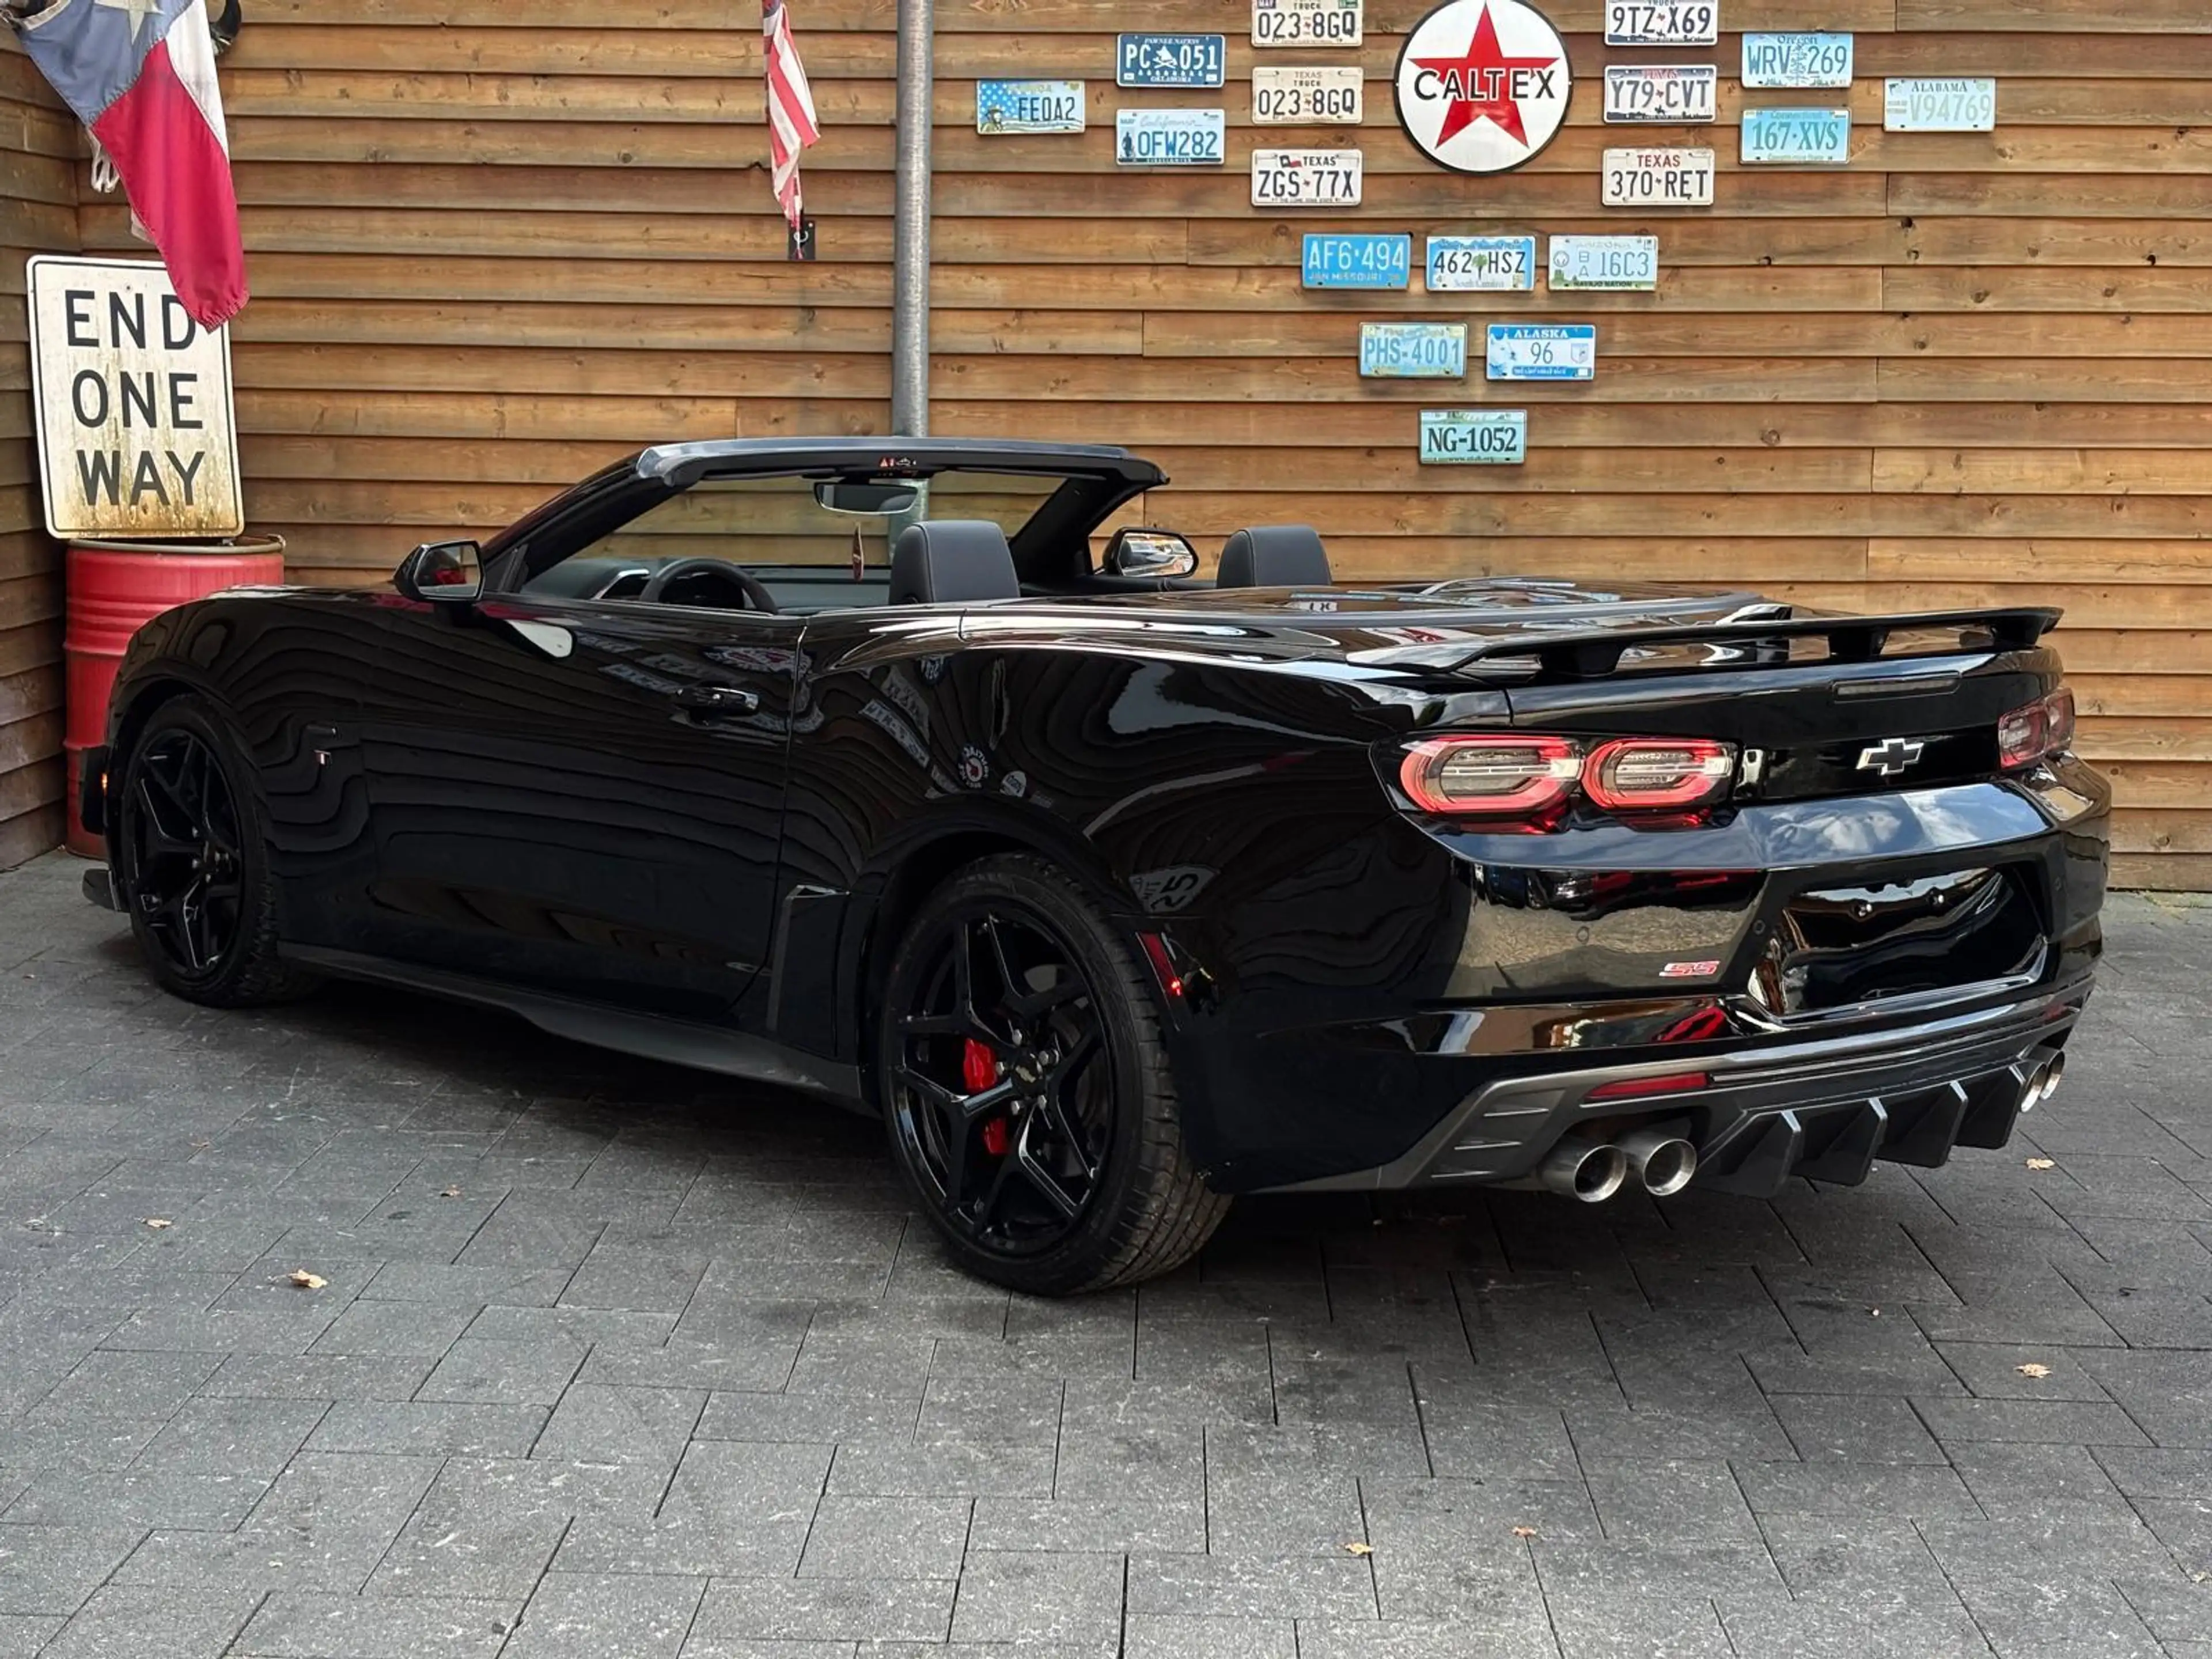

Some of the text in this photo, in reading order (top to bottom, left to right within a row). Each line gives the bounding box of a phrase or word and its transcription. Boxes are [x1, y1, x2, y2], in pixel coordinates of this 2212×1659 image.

[1258, 11, 1355, 38] 023 8GQ
[1612, 6, 1711, 34] 9TZ X69
[1126, 44, 1218, 70] PC 051
[1748, 45, 1847, 75] WRV 269
[1414, 69, 1555, 101] CALTEX
[1612, 80, 1710, 108] Y79 CVT
[1911, 81, 1968, 92] ALABAMA
[1259, 88, 1355, 115] 023 8GQ
[1910, 94, 1991, 122] V94769
[1303, 156, 1336, 166] TEXAS
[1637, 155, 1681, 168] TEXAS
[1258, 170, 1353, 198] ZGS 77X
[1611, 170, 1709, 198] 370 RET
[1434, 251, 1526, 274] 462 HSZ
[65, 290, 196, 350] END
[1514, 329, 1569, 339] ALASKA
[1531, 342, 1554, 365] 96
[72, 369, 203, 429] ONE
[1427, 427, 1517, 453] NG-1052
[77, 450, 205, 507] WAY
